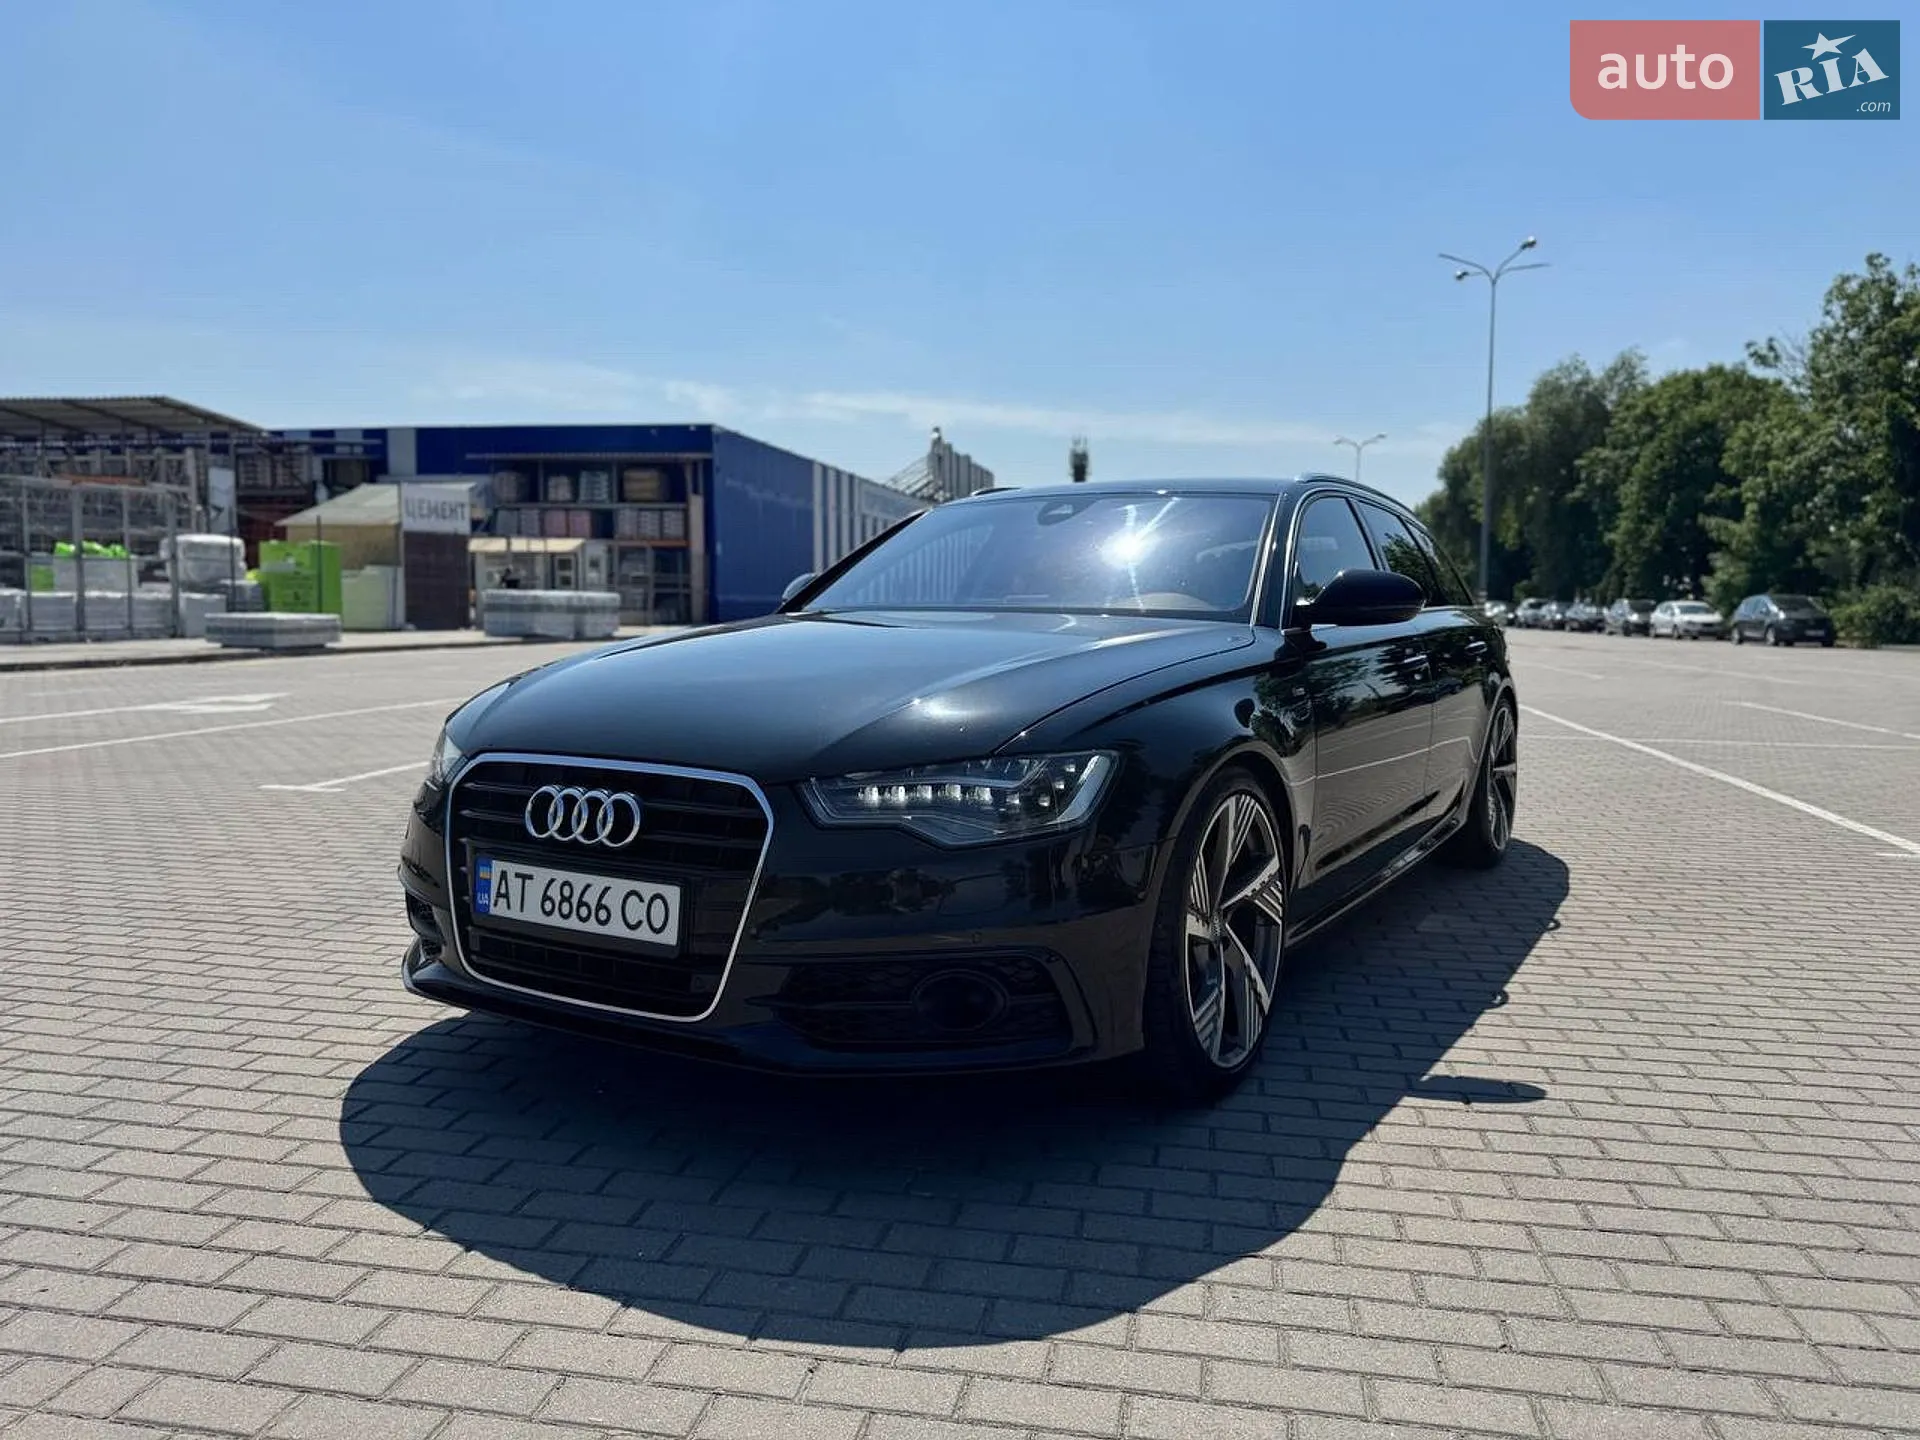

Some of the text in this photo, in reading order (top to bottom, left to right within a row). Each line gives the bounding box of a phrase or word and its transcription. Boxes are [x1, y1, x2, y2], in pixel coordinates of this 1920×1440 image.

[404, 497, 466, 522] ЦЕМЕНТ
[477, 891, 489, 906] UA
[493, 869, 670, 935] AT 6866 CO
